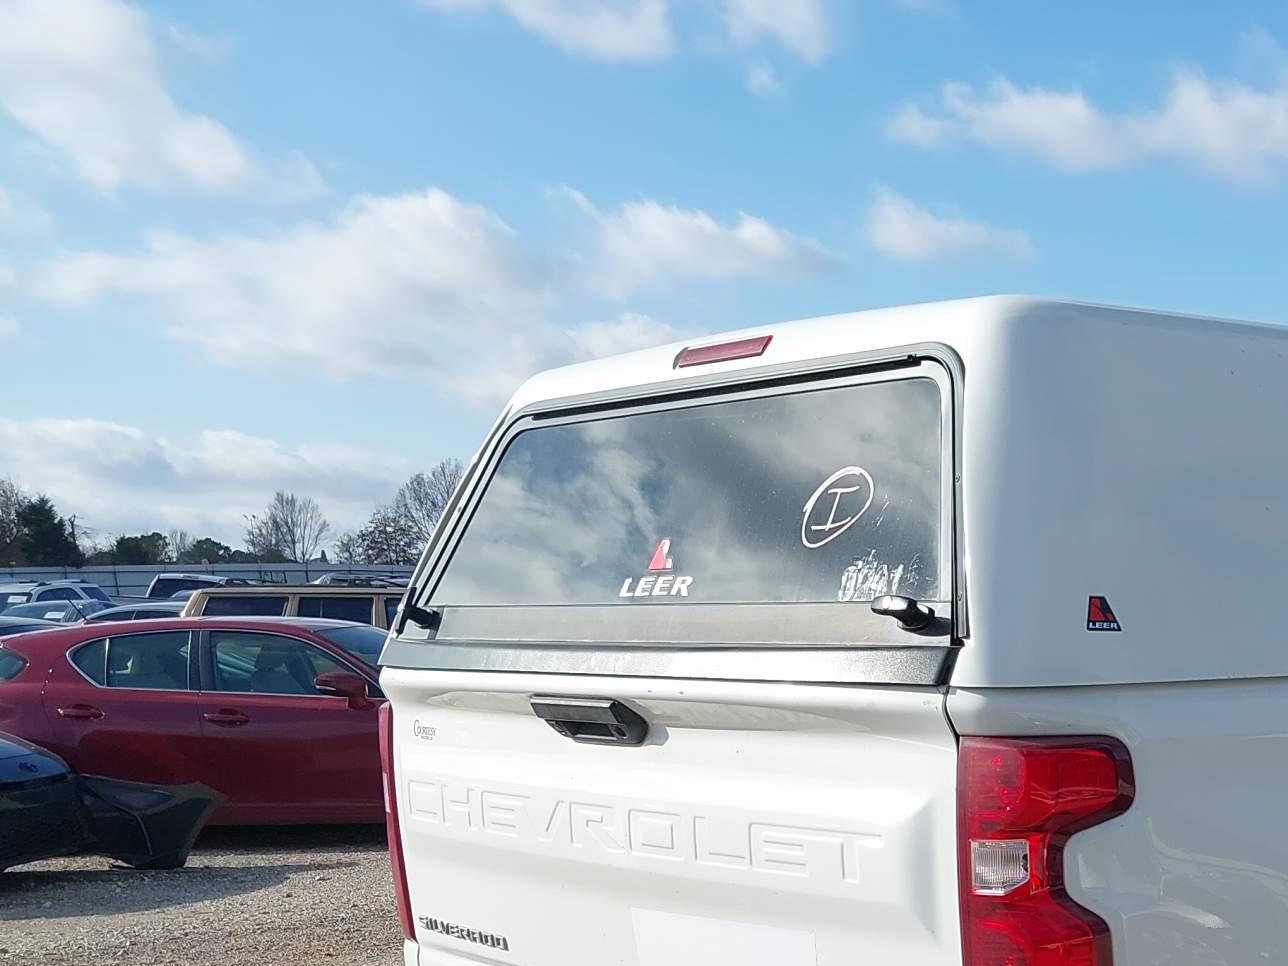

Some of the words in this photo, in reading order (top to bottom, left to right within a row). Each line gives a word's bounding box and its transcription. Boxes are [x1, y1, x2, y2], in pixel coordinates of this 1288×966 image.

[619, 575, 694, 597] LEER
[1088, 622, 1118, 630] LEER
[407, 778, 886, 884] CHEVROLET
[418, 914, 510, 952] SILVERADO
